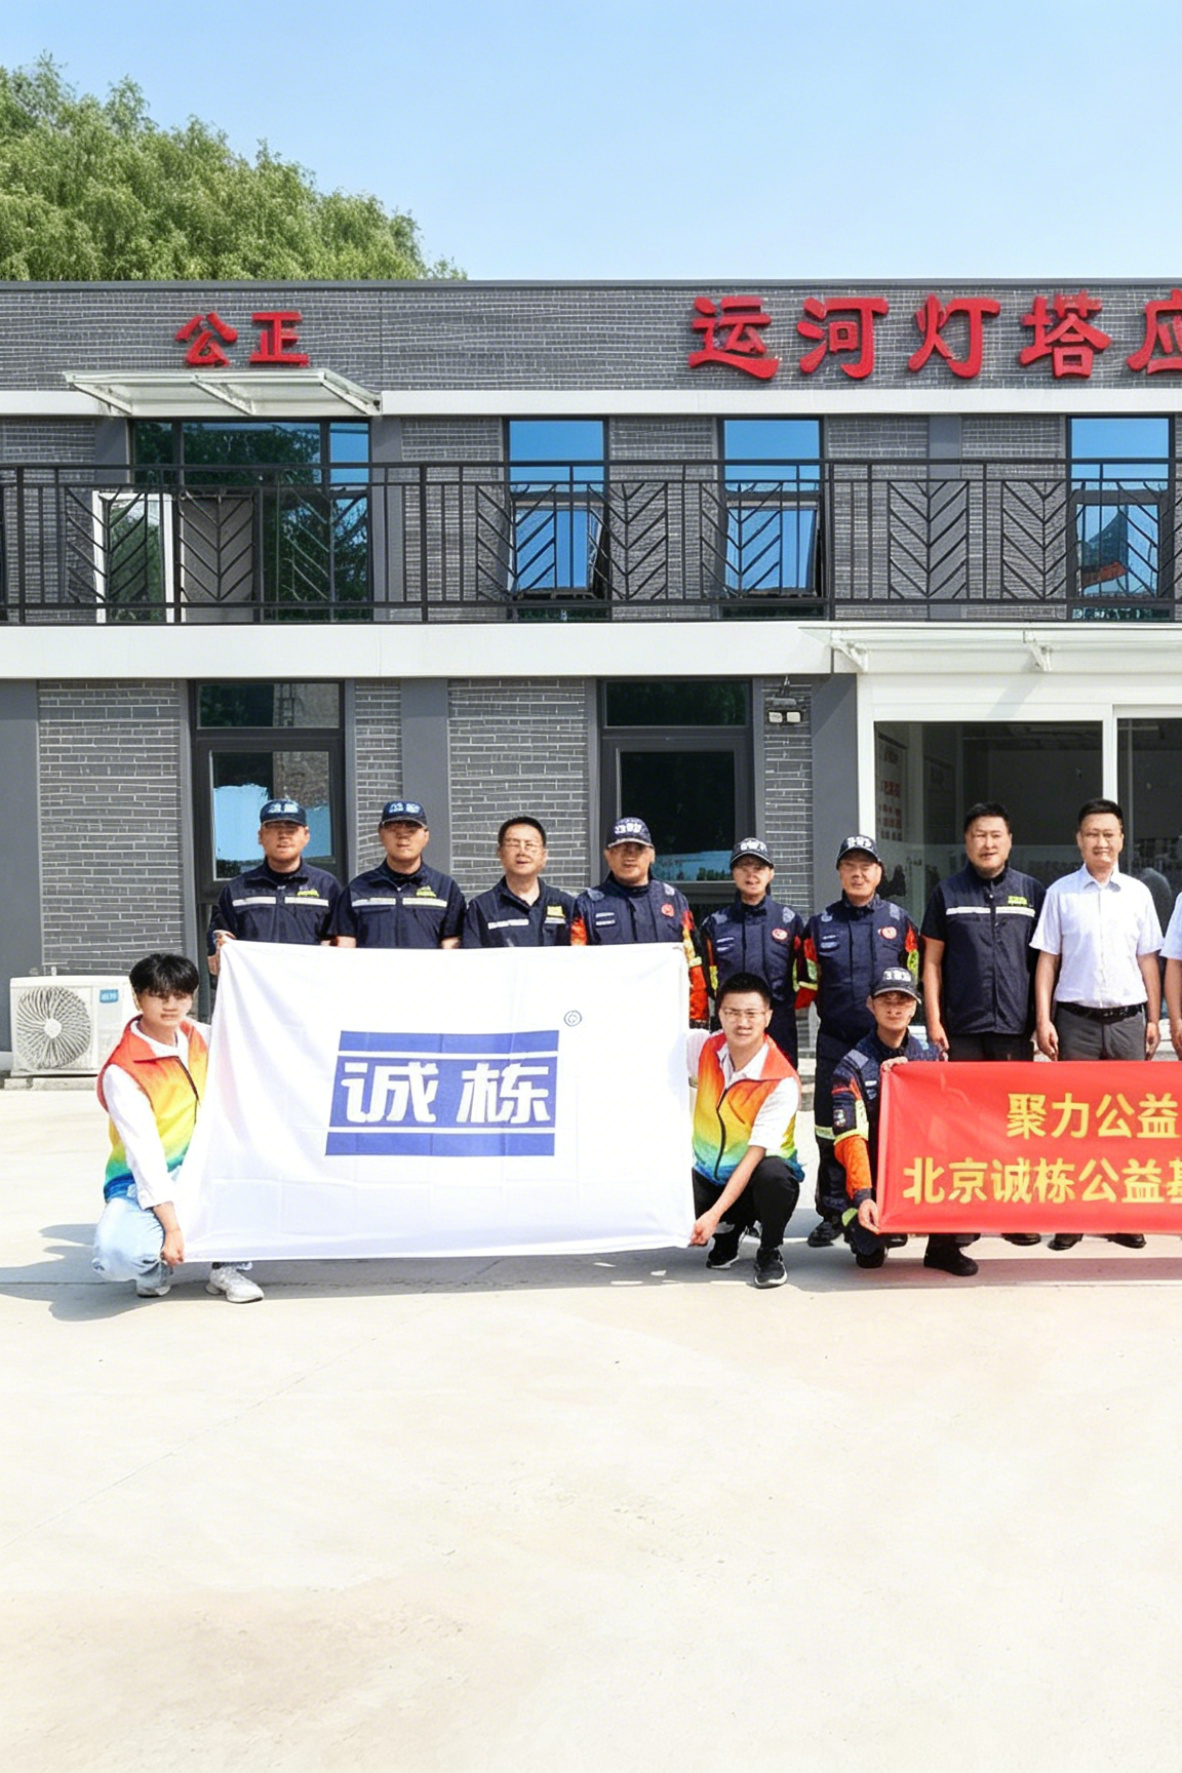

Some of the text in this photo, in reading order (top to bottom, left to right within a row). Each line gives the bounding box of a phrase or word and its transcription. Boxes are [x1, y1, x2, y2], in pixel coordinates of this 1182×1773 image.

[176, 311, 308, 366] 公正
[341, 1062, 551, 1123] 诚栋
[1006, 1093, 1179, 1139] 聚力公益
